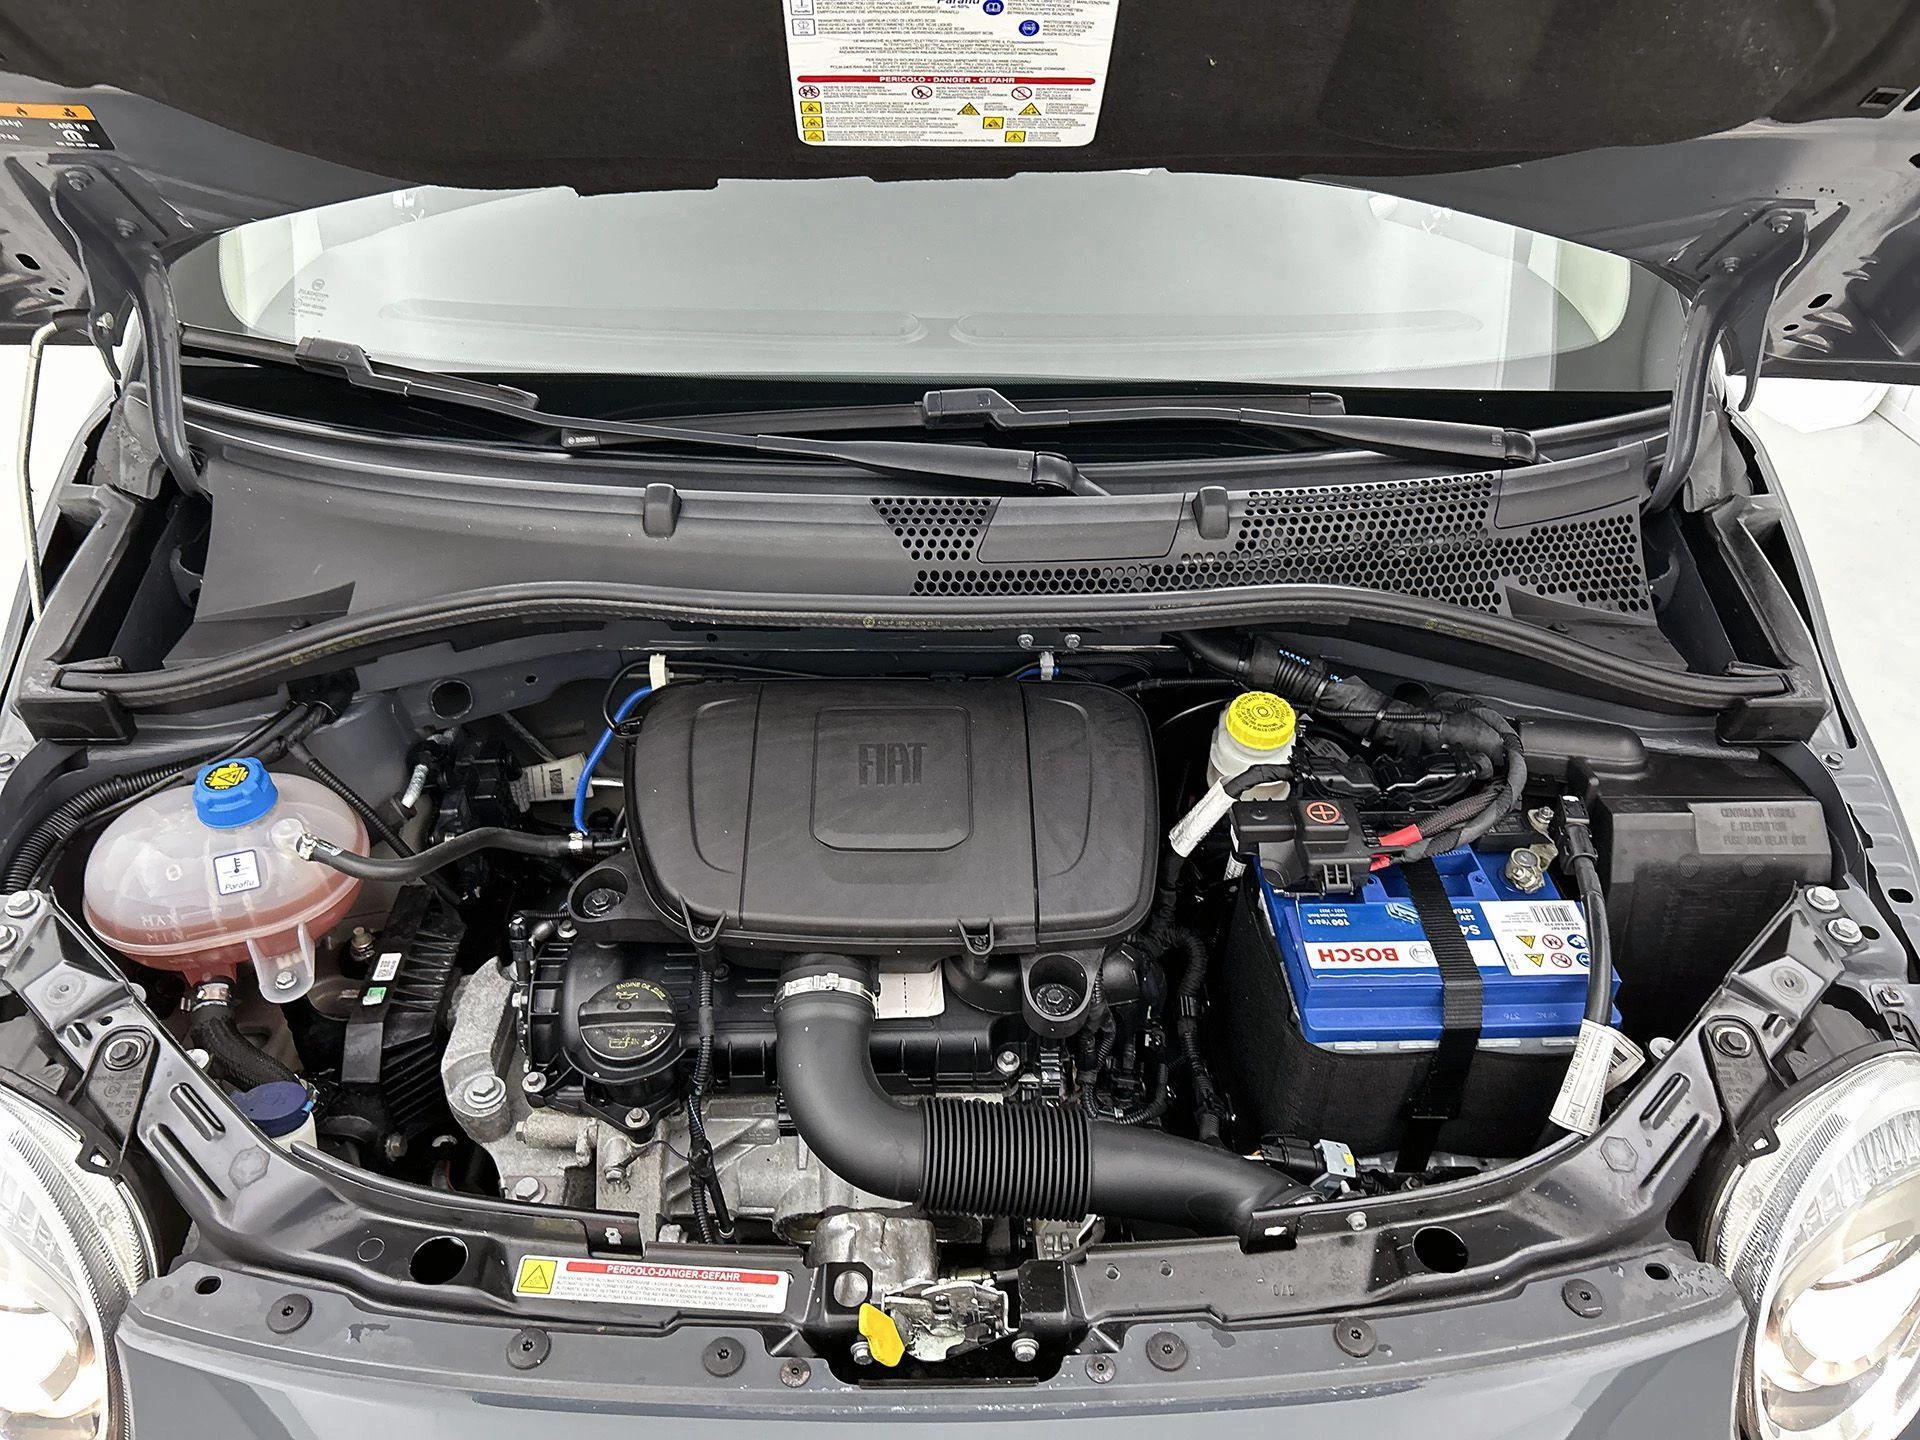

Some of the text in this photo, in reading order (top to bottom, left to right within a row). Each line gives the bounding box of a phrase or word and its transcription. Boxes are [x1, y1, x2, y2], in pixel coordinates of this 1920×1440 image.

[858, 743, 928, 784] FIAT
[1747, 836, 1762, 845] AND
[140, 908, 178, 926] MAX
[146, 930, 184, 942] MIN
[1460, 924, 1480, 936] S4
[1318, 948, 1399, 963] BOSCH
[1574, 1030, 1591, 1059] TRECCIA
[606, 1264, 740, 1282] PERICOLO-DANGER-GEFAHR
